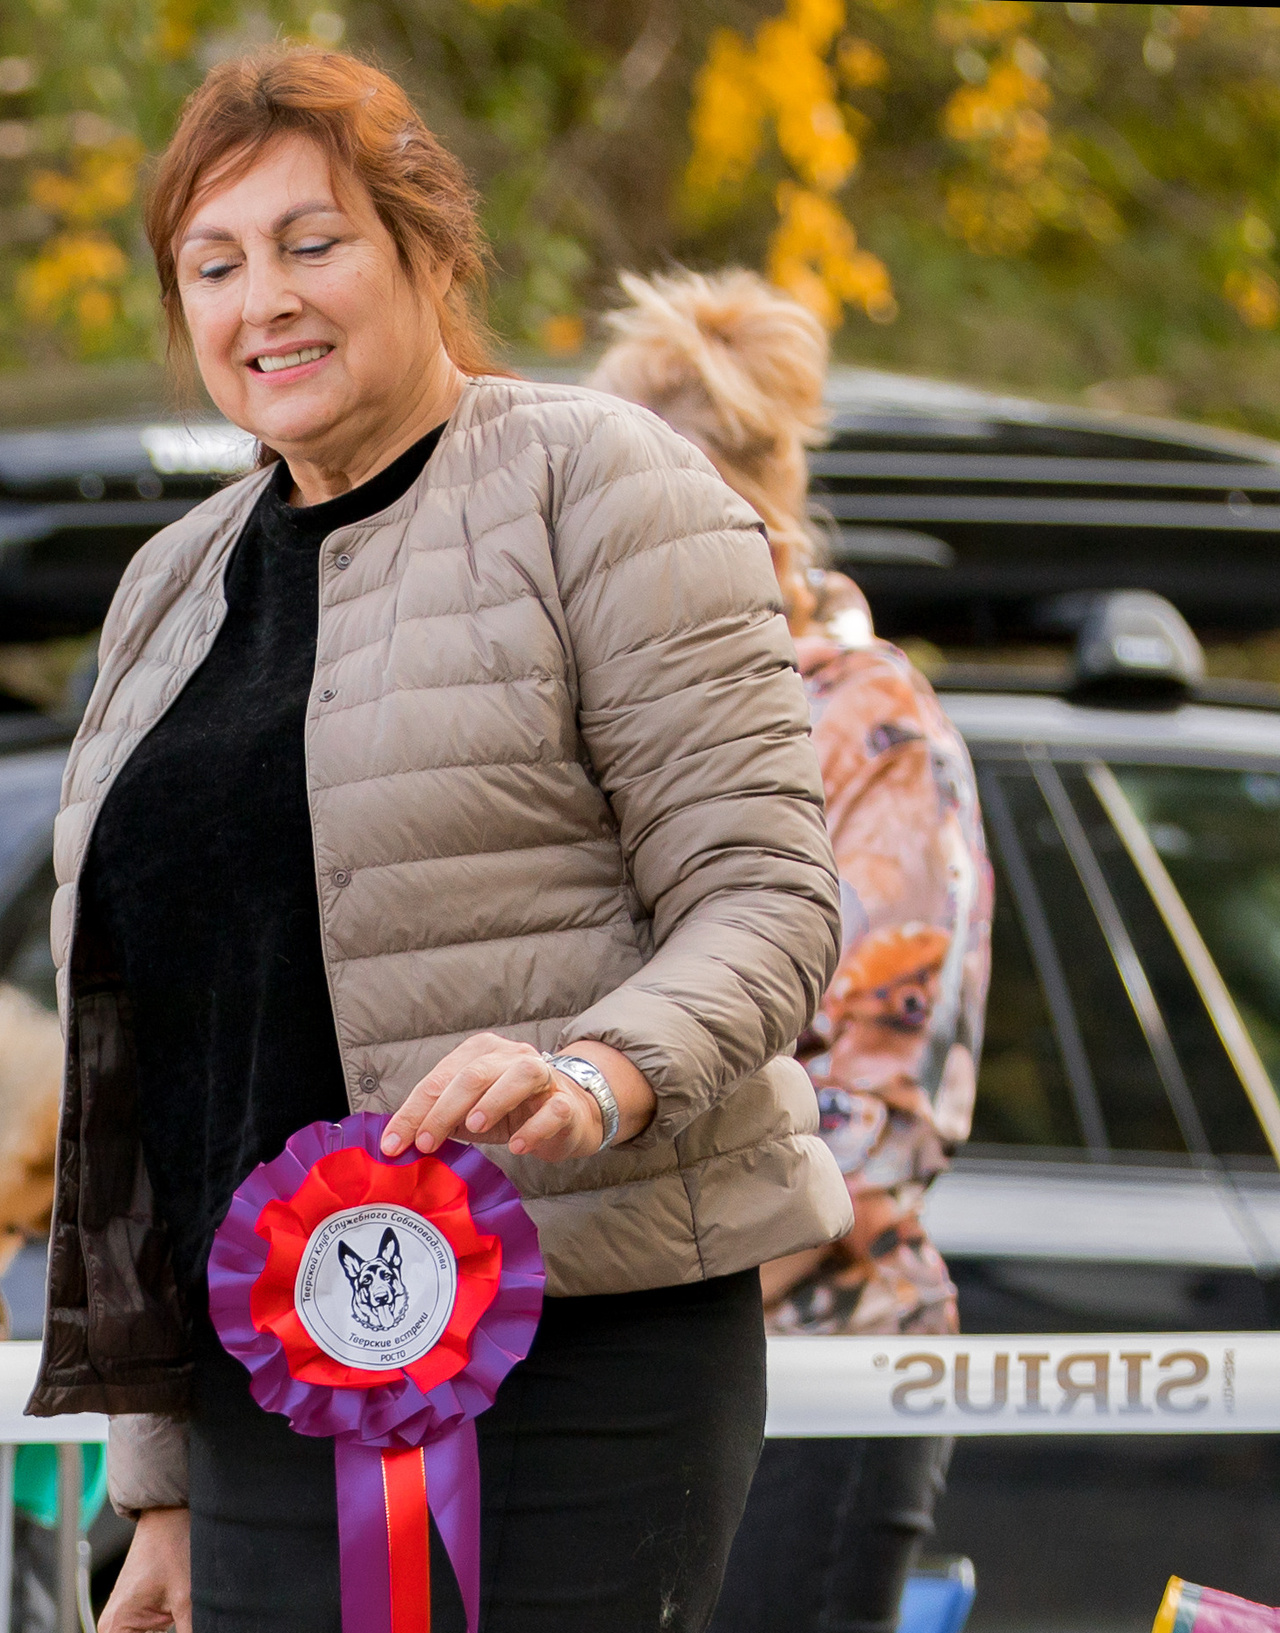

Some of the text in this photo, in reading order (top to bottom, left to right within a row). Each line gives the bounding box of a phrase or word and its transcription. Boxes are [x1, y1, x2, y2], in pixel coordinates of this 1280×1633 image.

[302, 1212, 447, 1302] Тверской Клуб Служебного Собаководства
[348, 1312, 429, 1349] Тверские встречи
[380, 1350, 406, 1362] РОСТО
